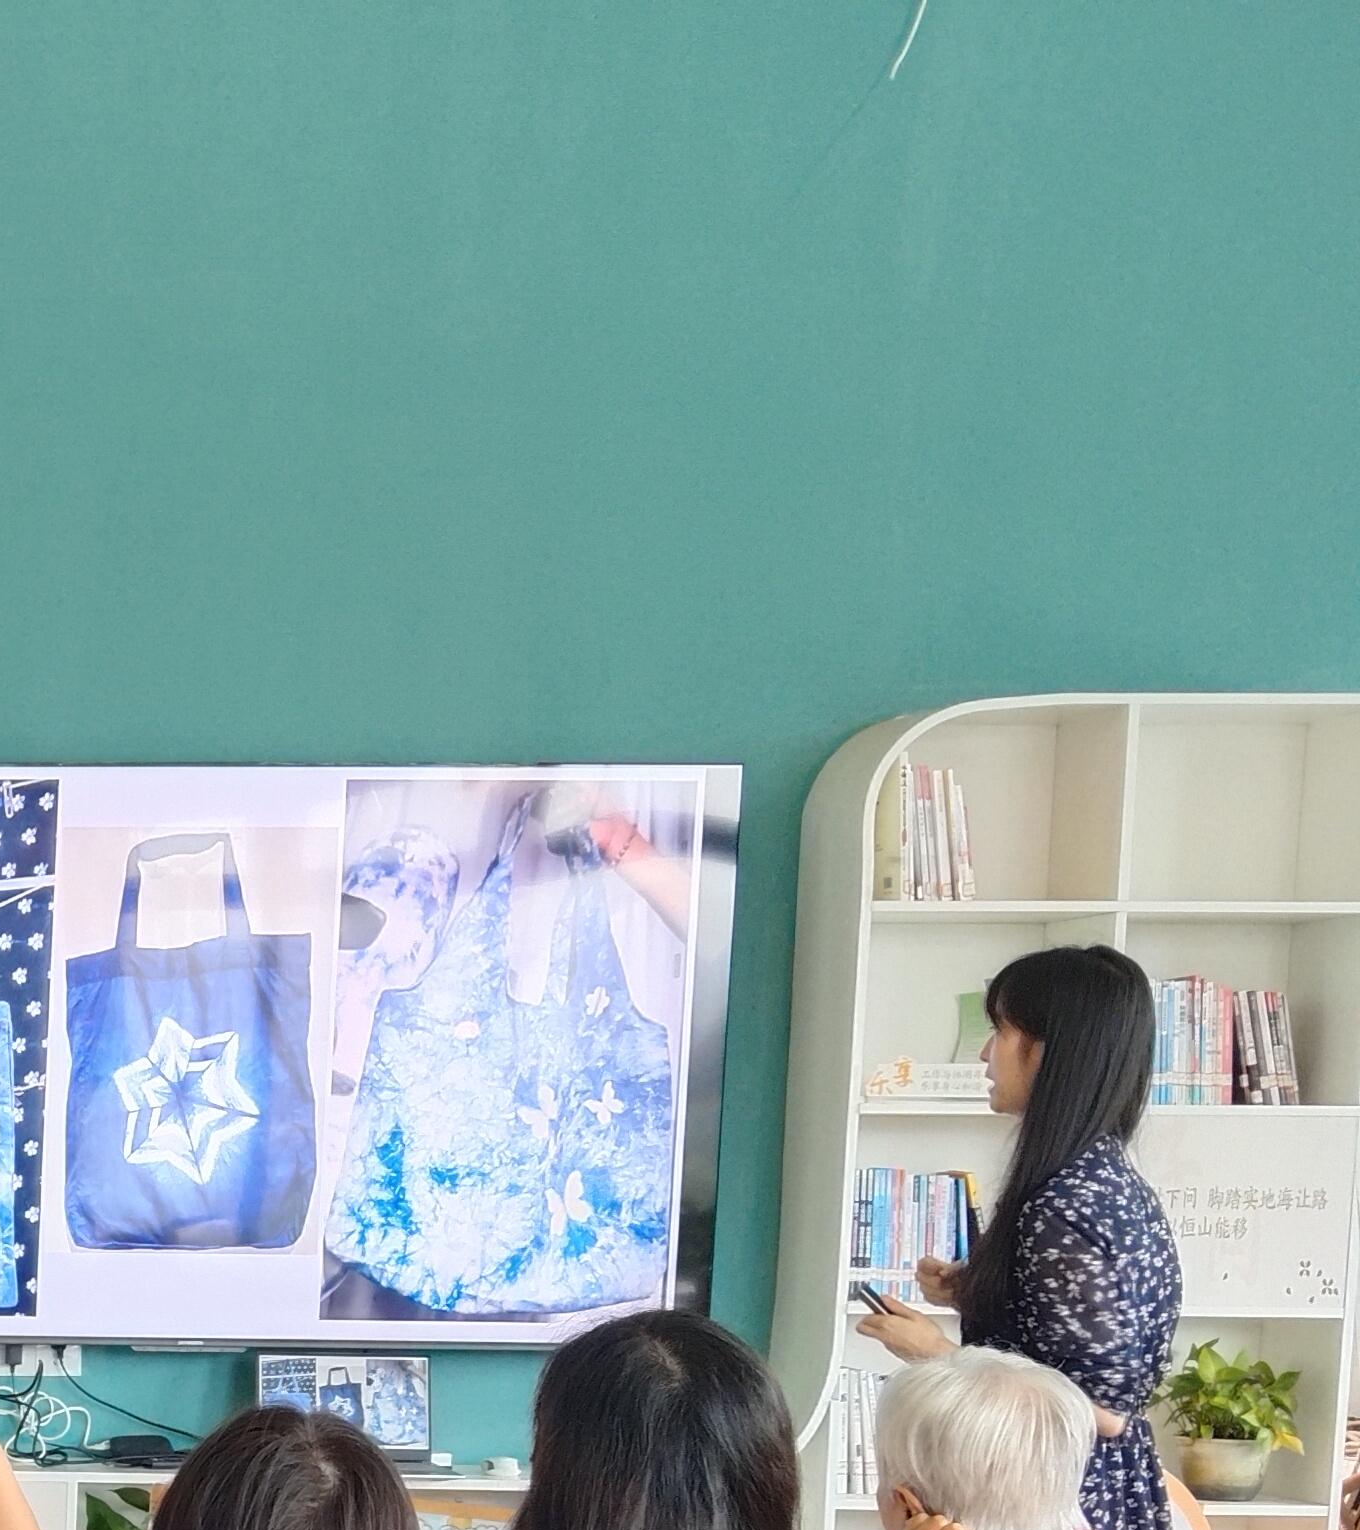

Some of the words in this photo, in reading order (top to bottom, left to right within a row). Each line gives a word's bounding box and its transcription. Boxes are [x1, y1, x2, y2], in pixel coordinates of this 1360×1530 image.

[1208, 1186, 1328, 1210] 脚踏实地海让路
